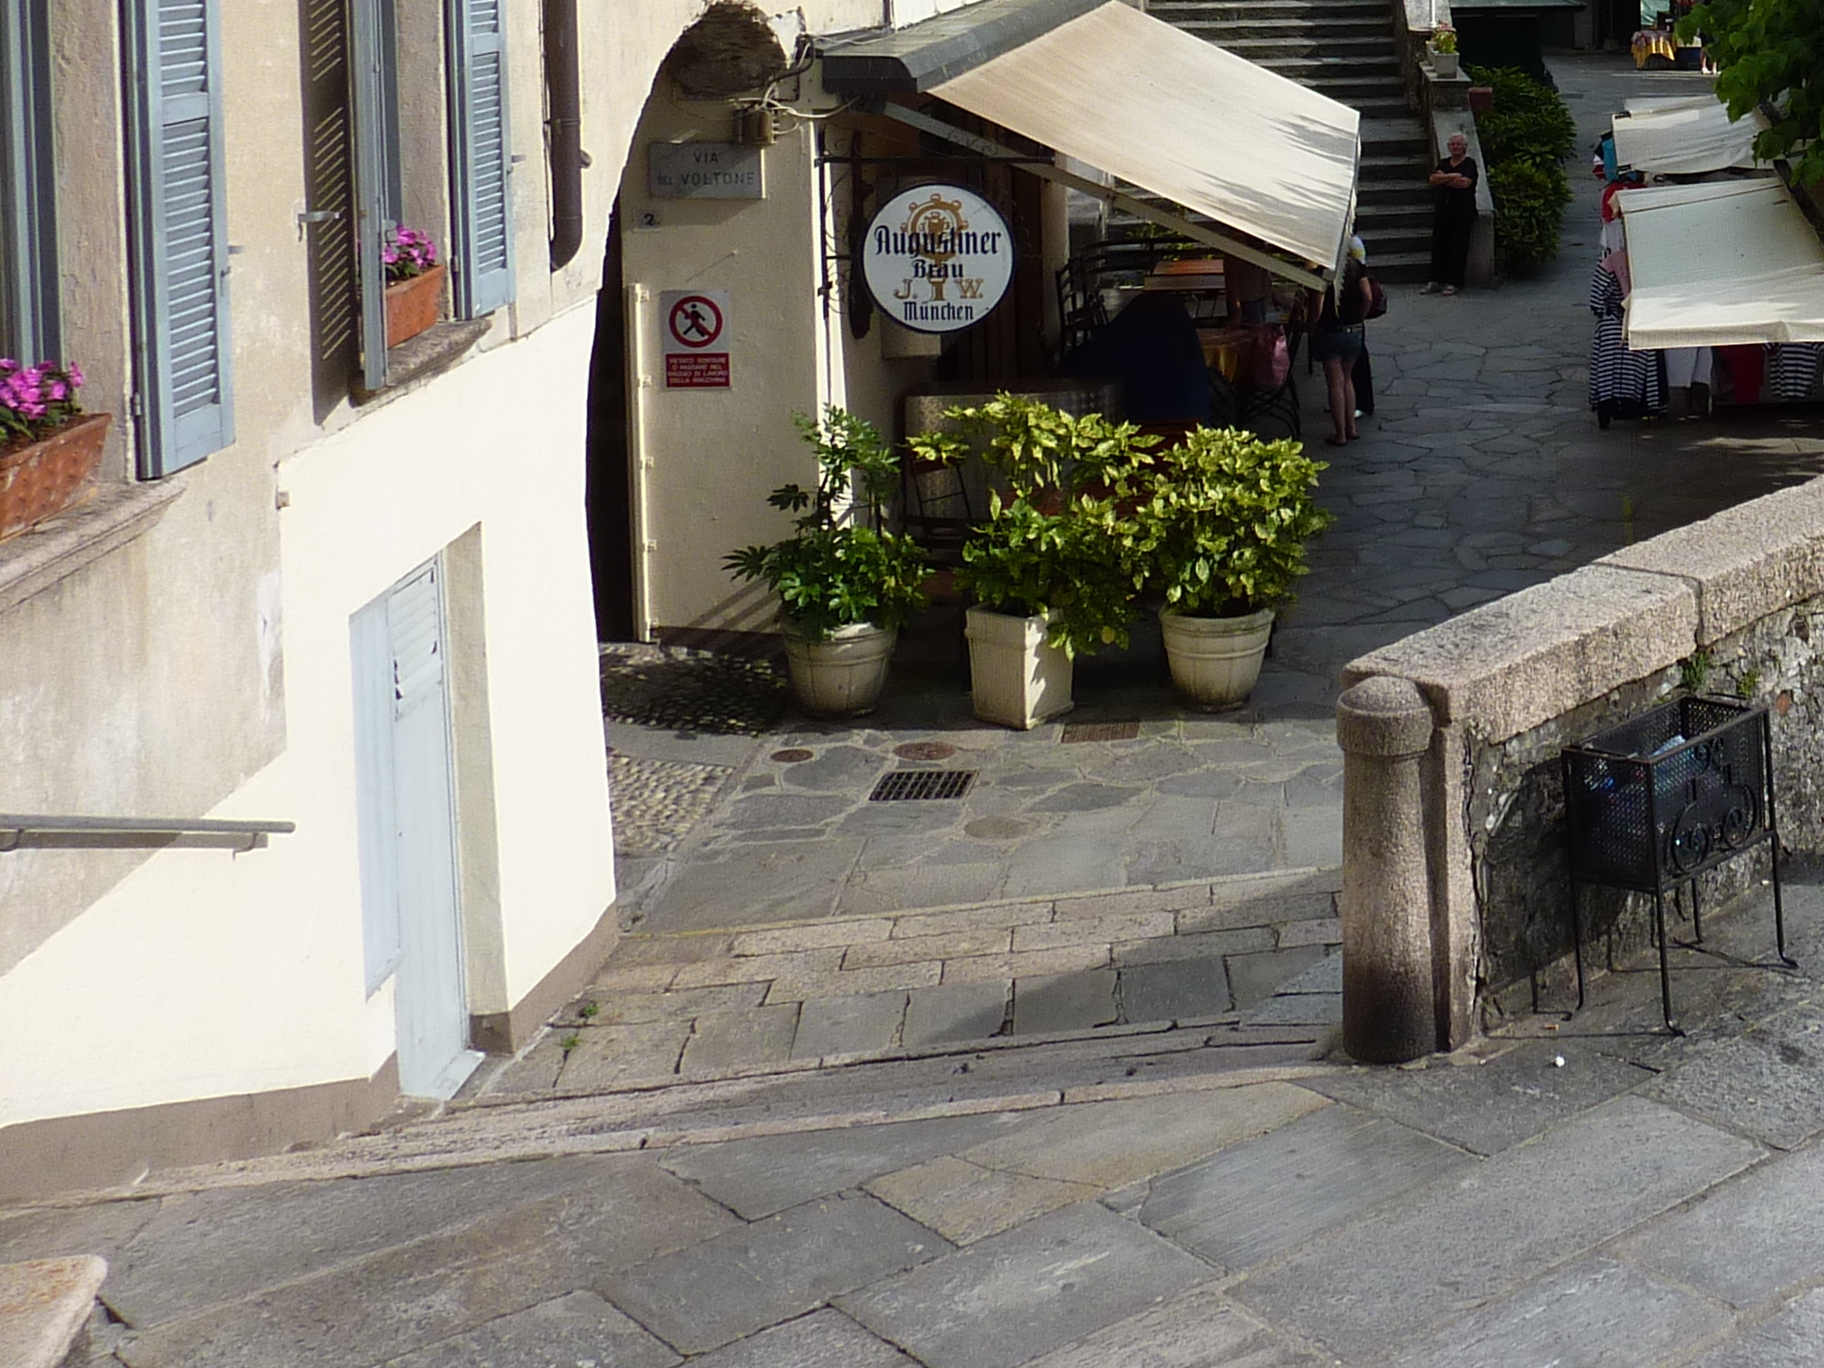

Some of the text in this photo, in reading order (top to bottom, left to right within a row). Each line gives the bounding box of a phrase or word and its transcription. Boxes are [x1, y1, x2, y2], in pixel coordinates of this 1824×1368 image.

[694, 152, 719, 163] VIA
[681, 172, 755, 185] VOLTONE
[644, 213, 655, 226] 2
[874, 225, 1002, 258] Augustiner
[903, 301, 974, 320] München
